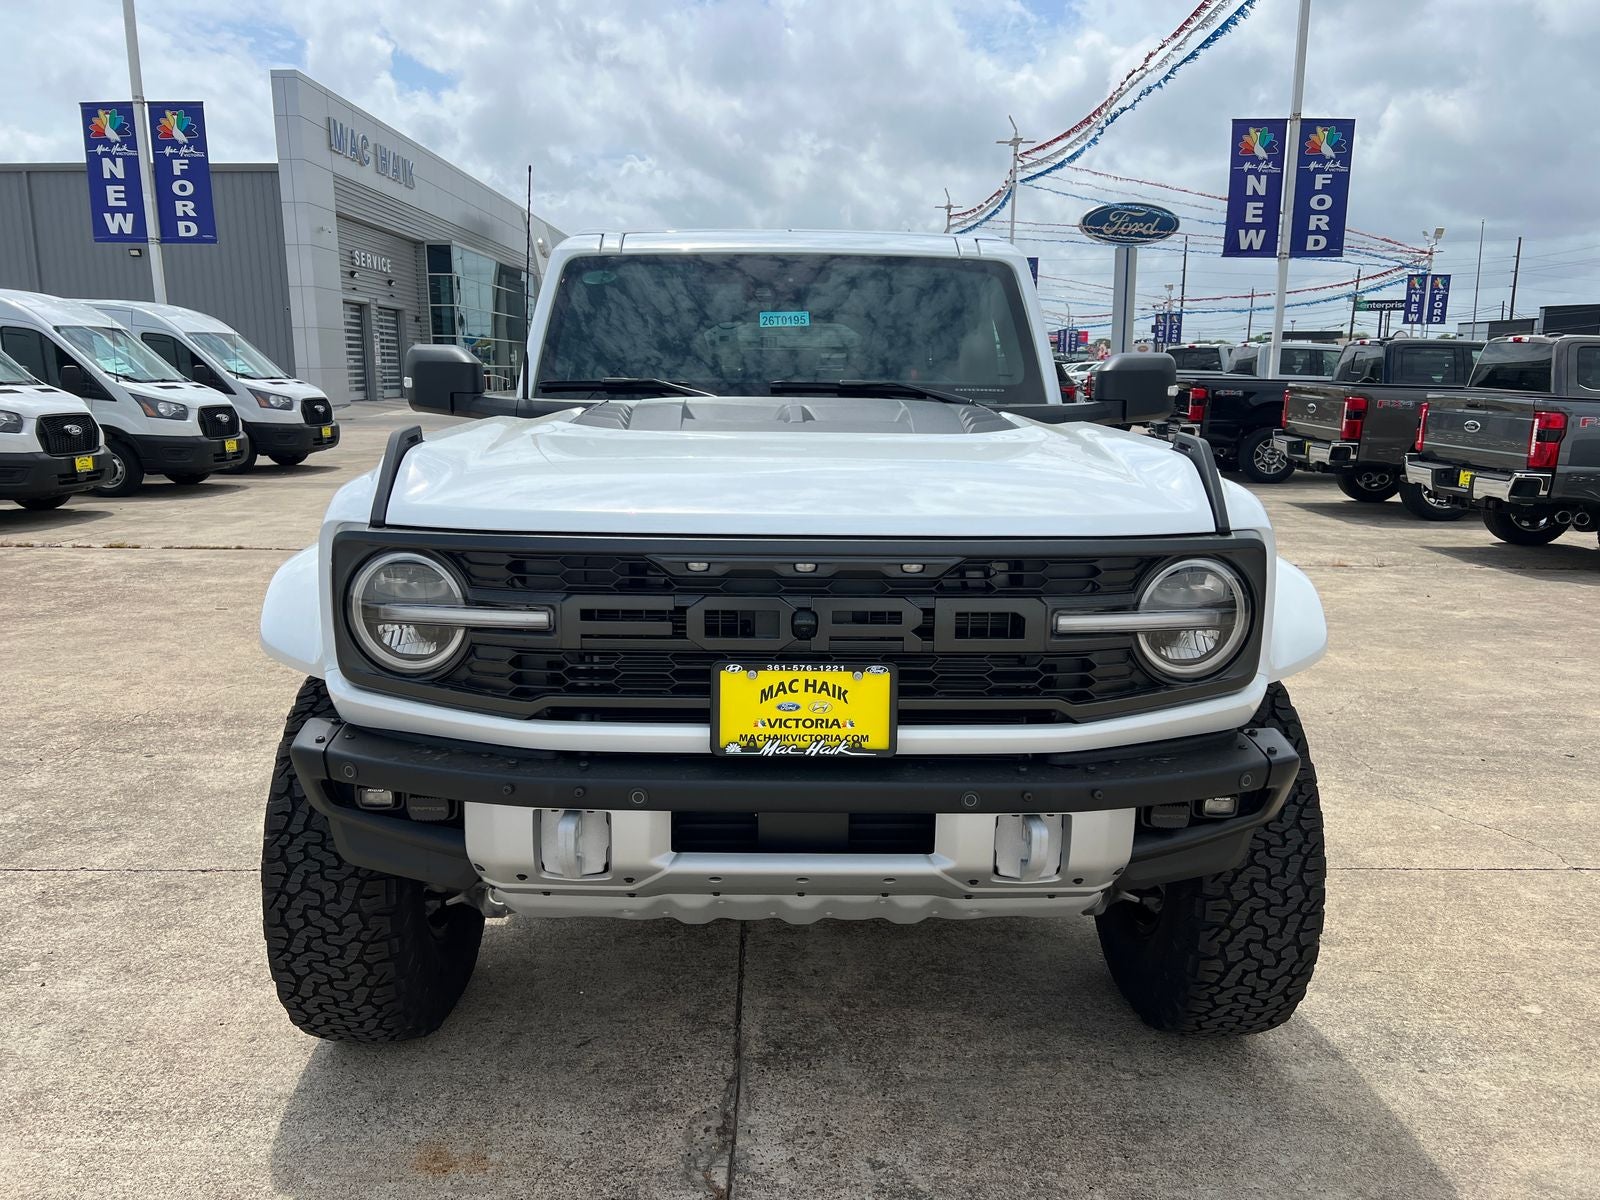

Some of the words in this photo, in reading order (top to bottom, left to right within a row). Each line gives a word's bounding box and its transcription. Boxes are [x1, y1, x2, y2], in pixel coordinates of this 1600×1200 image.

[328, 117, 370, 166] MAC
[374, 143, 415, 190] HAIK
[102, 158, 133, 234] NEW
[172, 160, 198, 236] FORD
[1102, 210, 1160, 235] Ford
[1238, 174, 1267, 250] NEW
[1306, 174, 1332, 251] FORD
[354, 250, 392, 273] SERVICE
[762, 315, 806, 326] 26T0195
[1408, 294, 1420, 322] NEW
[1432, 294, 1443, 322] FORD
[1377, 400, 1415, 409] FX4
[560, 596, 1047, 652] FORD
[767, 664, 845, 672] 361-576-1221
[760, 678, 799, 704] MAC
[804, 678, 848, 704] HAIK
[767, 718, 842, 728] VICTORIA
[739, 733, 869, 743] MACHAIKVICTORIA.COM
[758, 739, 797, 756] Mac
[804, 739, 852, 756] Haik
